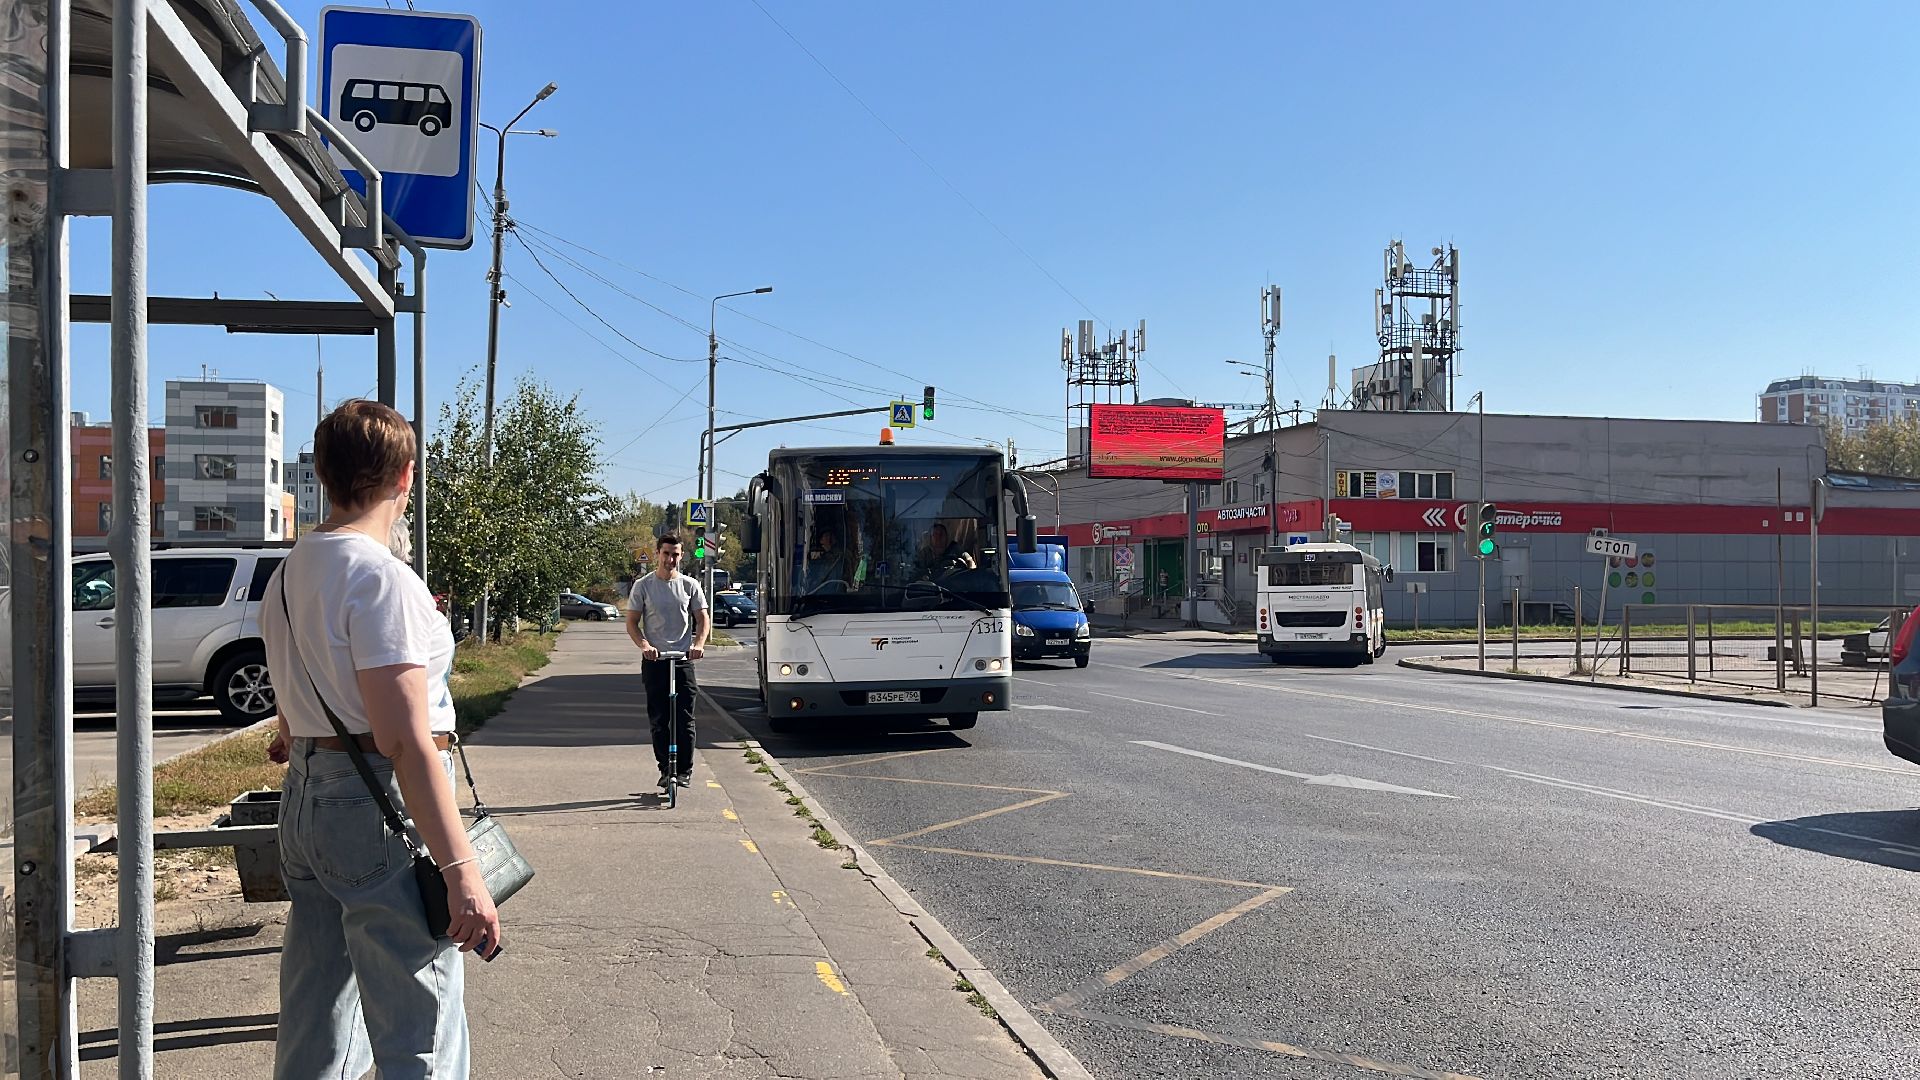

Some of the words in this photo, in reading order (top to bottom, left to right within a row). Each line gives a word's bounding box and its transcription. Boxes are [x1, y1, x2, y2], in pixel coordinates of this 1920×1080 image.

[1217, 506, 1266, 520] АВТОЗАПЧАСТИ
[1494, 512, 1562, 528] ятерочка
[1196, 523, 1209, 533] ОТО
[1594, 540, 1630, 555] СТОП
[977, 621, 1004, 634] 1312
